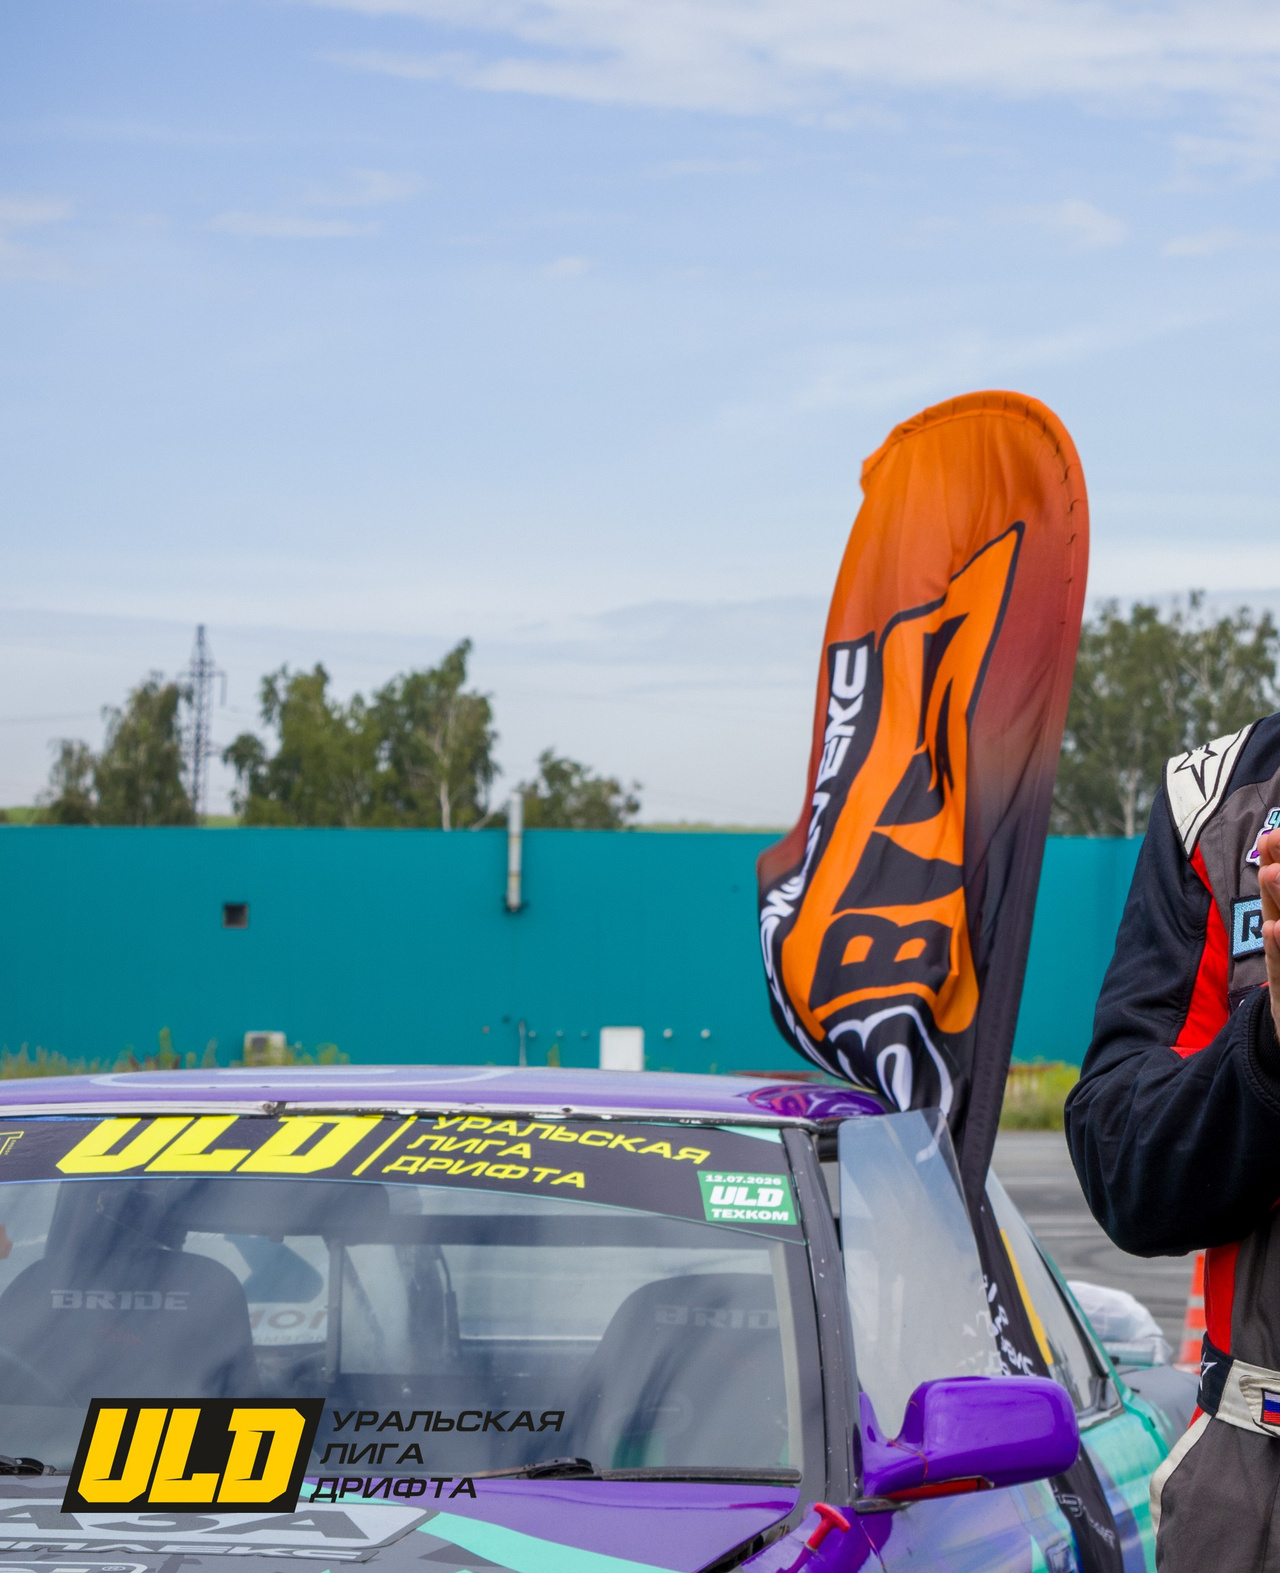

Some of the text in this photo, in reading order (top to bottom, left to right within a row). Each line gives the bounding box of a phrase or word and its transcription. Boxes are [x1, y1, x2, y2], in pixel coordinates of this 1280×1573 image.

[56, 1114, 385, 1174] ULD
[406, 1134, 533, 1159] ЛИГА
[432, 1116, 711, 1165] УРАЛЬСКАЯ
[382, 1155, 585, 1189] ДРИФТА
[709, 1185, 784, 1208] ULD
[711, 1208, 789, 1221] ТЕХКОМ
[50, 1289, 190, 1311] BRIDE
[655, 1305, 778, 1329] BRID
